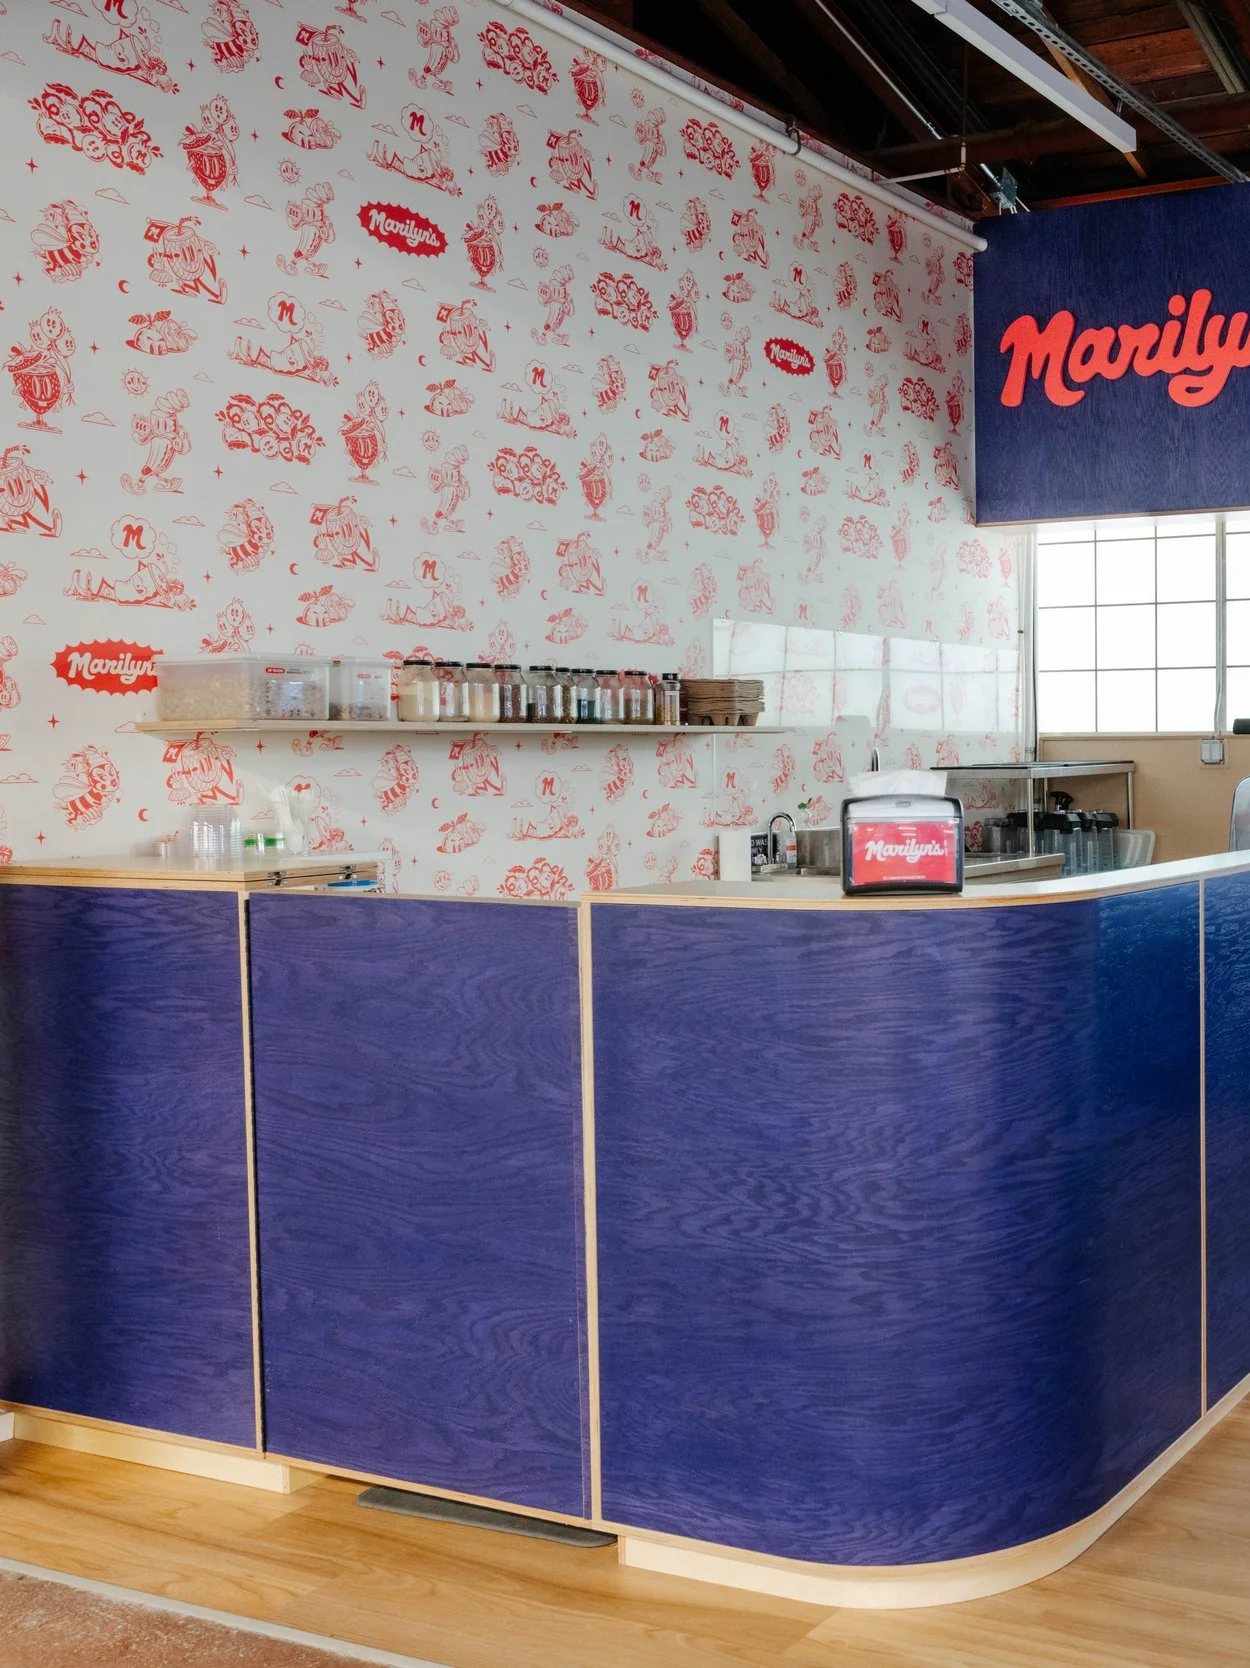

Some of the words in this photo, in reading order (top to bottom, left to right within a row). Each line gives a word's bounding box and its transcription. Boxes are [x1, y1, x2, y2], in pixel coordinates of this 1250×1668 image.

[369, 209, 440, 247] Marilyn's
[770, 343, 810, 369] Marilyn's
[68, 652, 157, 684] Marilyn
[865, 838, 944, 864] Marilyn's
